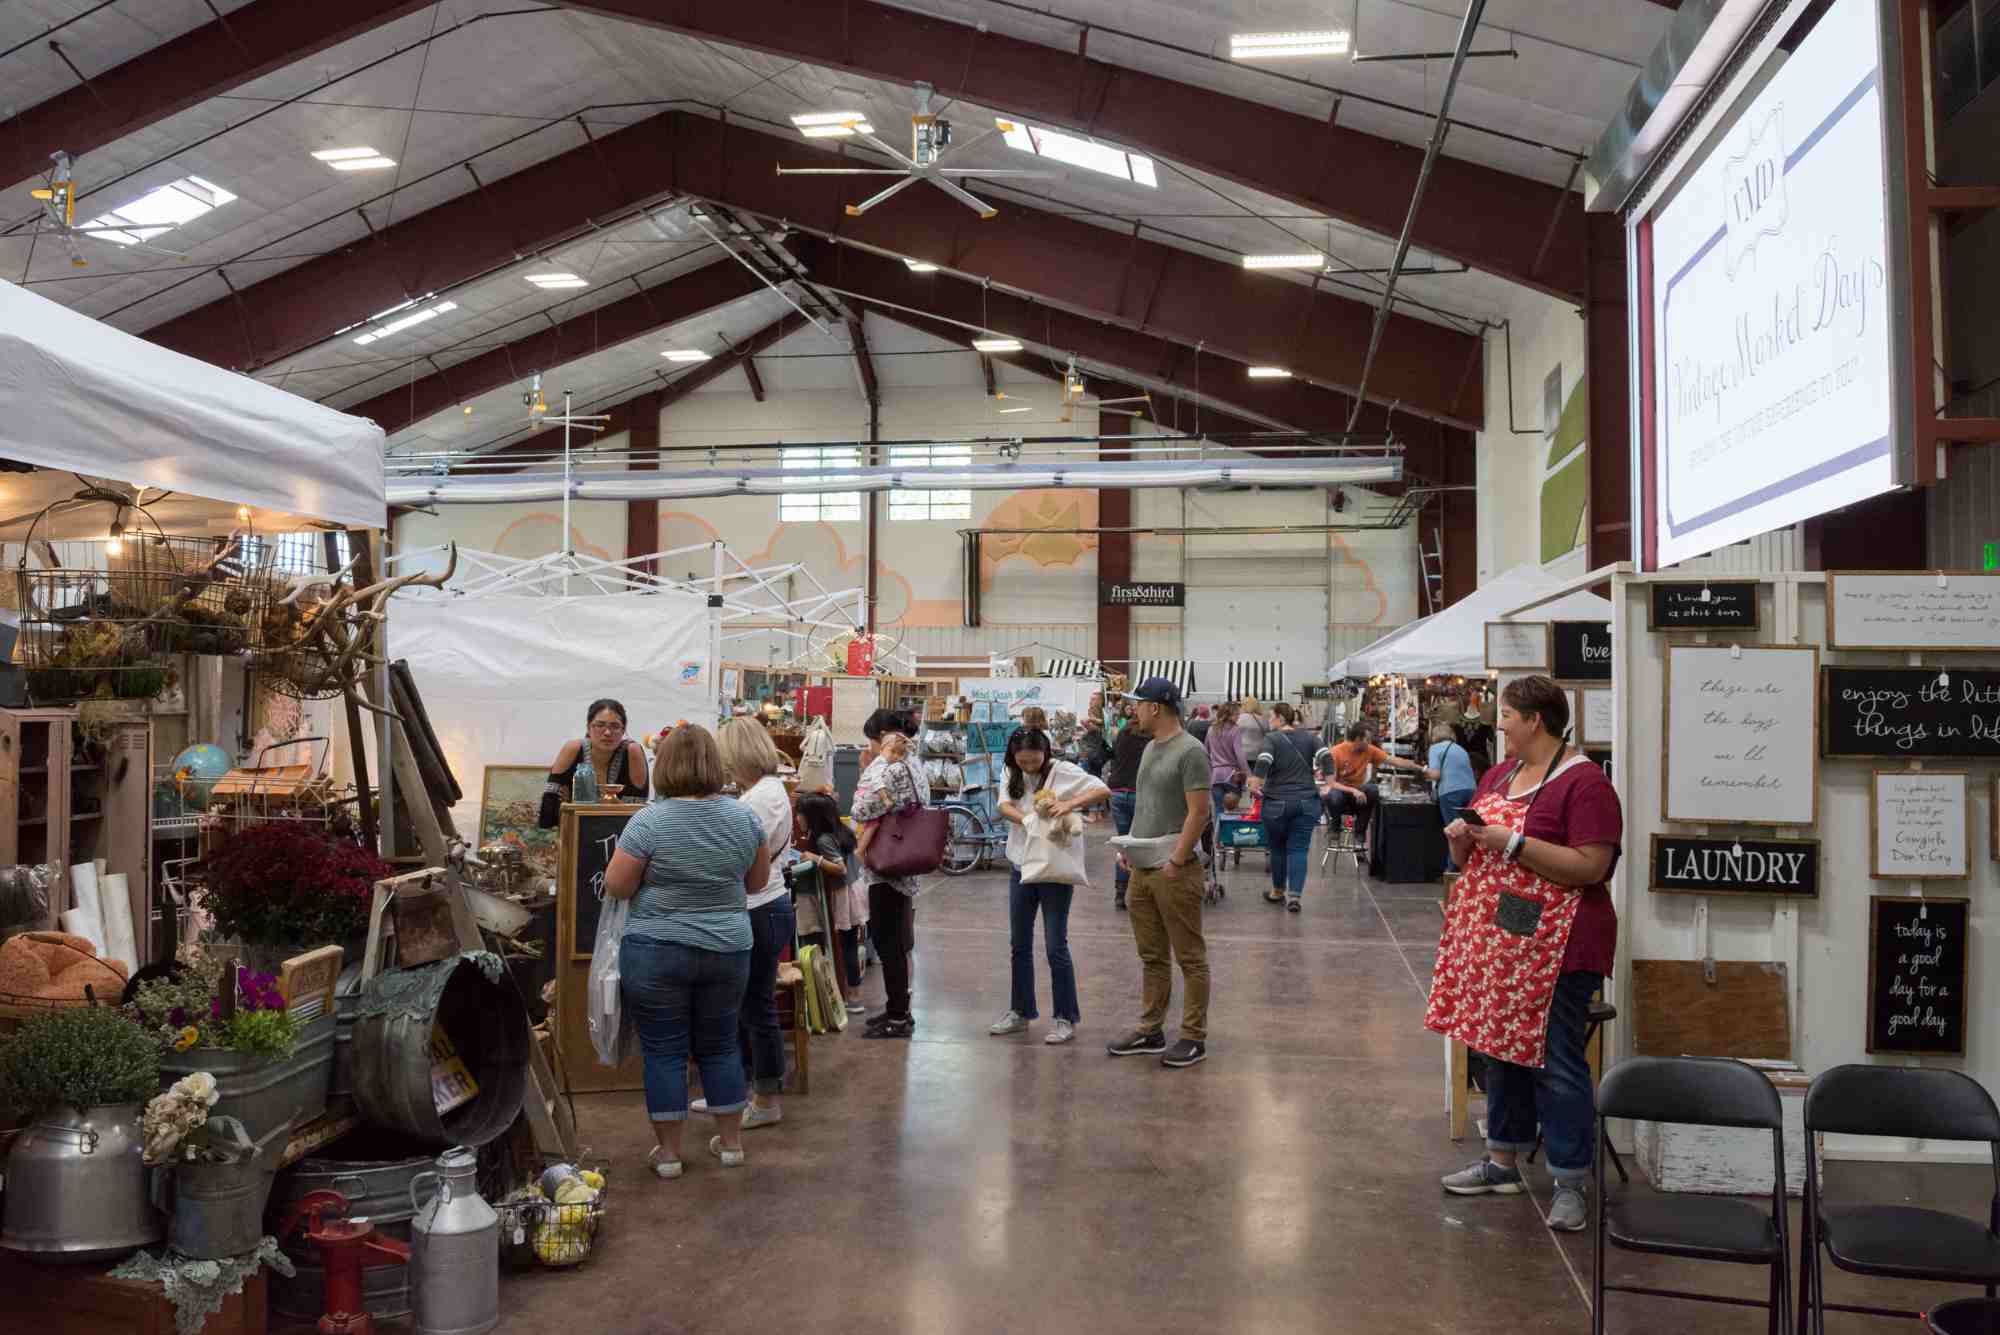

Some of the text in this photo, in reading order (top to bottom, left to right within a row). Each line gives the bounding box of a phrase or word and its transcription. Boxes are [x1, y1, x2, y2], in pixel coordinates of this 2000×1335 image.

[1674, 354, 1732, 425] Vintage
[1732, 283, 1805, 388] Market
[1700, 679, 1785, 698] these are
[1842, 687, 1913, 715] enjoy
[1917, 678, 1952, 703] the
[1703, 710, 1737, 724] the
[1852, 711, 1932, 749] things
[1937, 724, 1961, 737] in
[1700, 773, 1784, 790] remember
[1664, 847, 1806, 885] LAUNDRY
[1894, 918, 1948, 947] today is
[1898, 945, 1943, 975] a good
[1889, 975, 1949, 1006] day for a
[1887, 1005, 1948, 1037] good day
